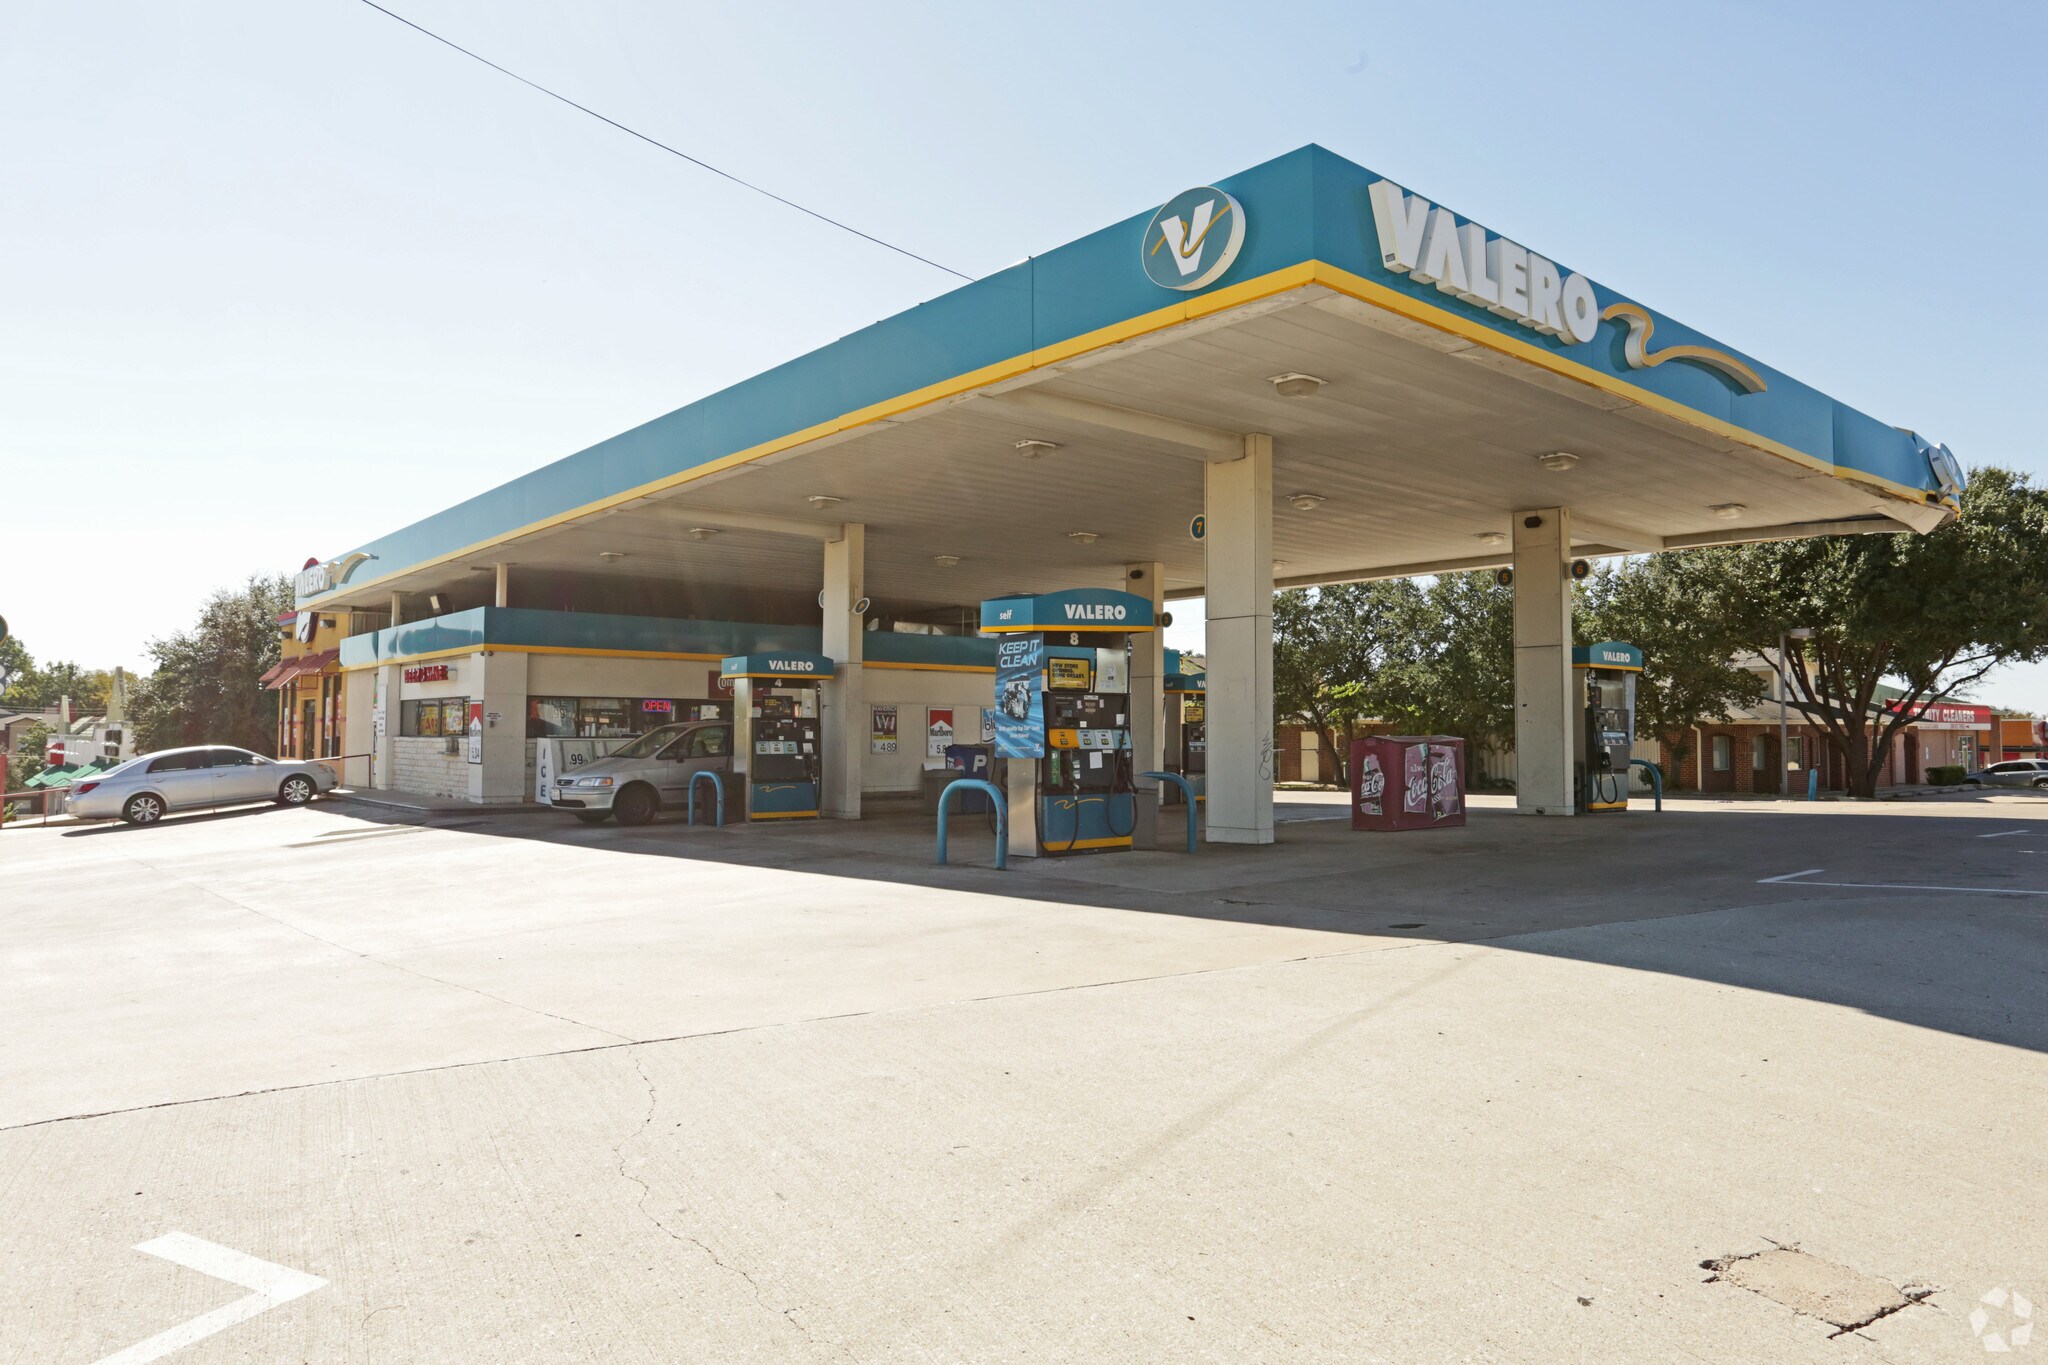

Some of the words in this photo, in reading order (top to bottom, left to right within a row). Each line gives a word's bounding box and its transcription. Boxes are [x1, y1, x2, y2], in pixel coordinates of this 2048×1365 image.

[1159, 198, 1216, 277] V
[1368, 178, 1599, 346] VALERO
[1196, 521, 1203, 533] 7
[1577, 565, 1583, 575] 6
[1502, 573, 1508, 583] 5
[999, 609, 1013, 620] self
[1064, 603, 1127, 620] VALERO
[1069, 632, 1079, 645] 8
[999, 642, 1028, 655] KEEP
[1029, 639, 1040, 652] IT
[1000, 655, 1038, 668] CLEAN
[1603, 651, 1631, 662] VALERO
[768, 660, 814, 672] VALERO
[775, 679, 783, 687] 4
[643, 700, 671, 712] OPEN
[1943, 709, 1975, 722] CLEANERS
[929, 728, 953, 737] Marlboro
